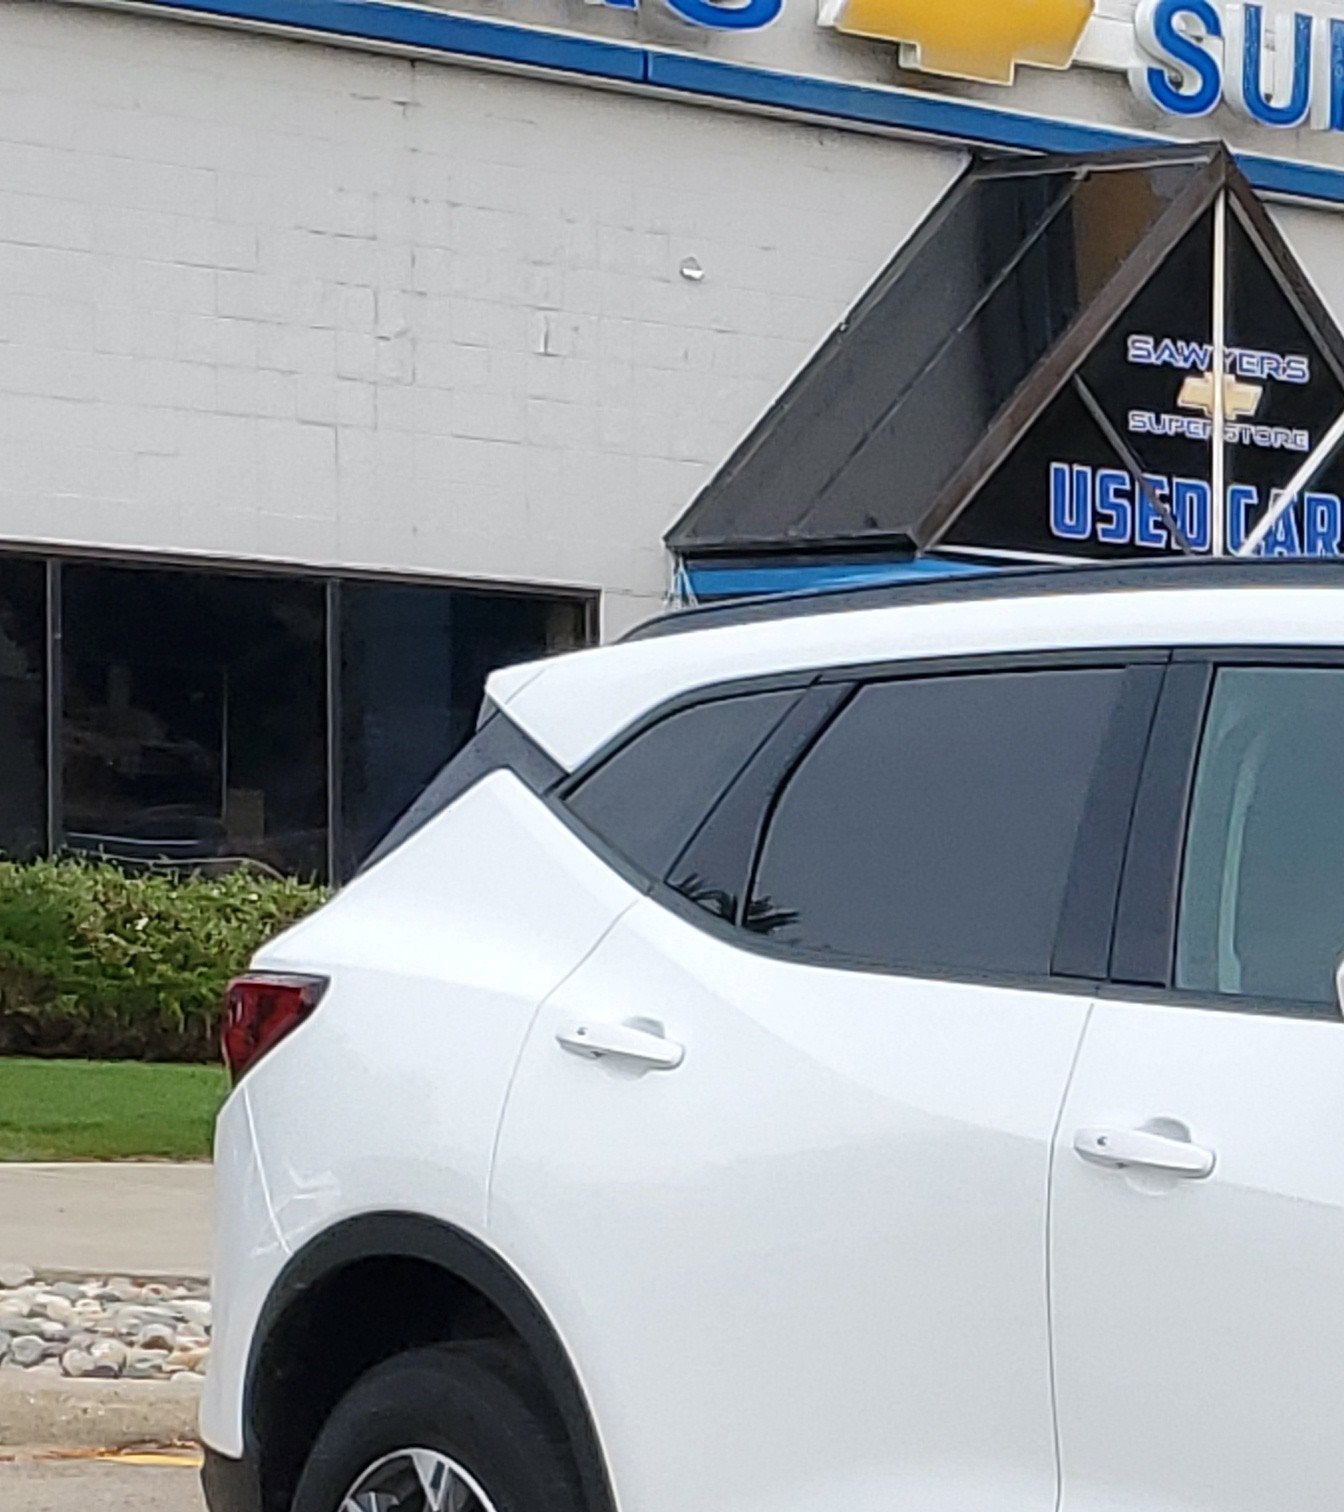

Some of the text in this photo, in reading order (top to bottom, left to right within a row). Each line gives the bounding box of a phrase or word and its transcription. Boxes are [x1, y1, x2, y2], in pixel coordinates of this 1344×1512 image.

[1126, 333, 1311, 384] SAWYERS
[1127, 409, 1310, 452] SUPESTORE
[1049, 461, 1213, 554] USED
